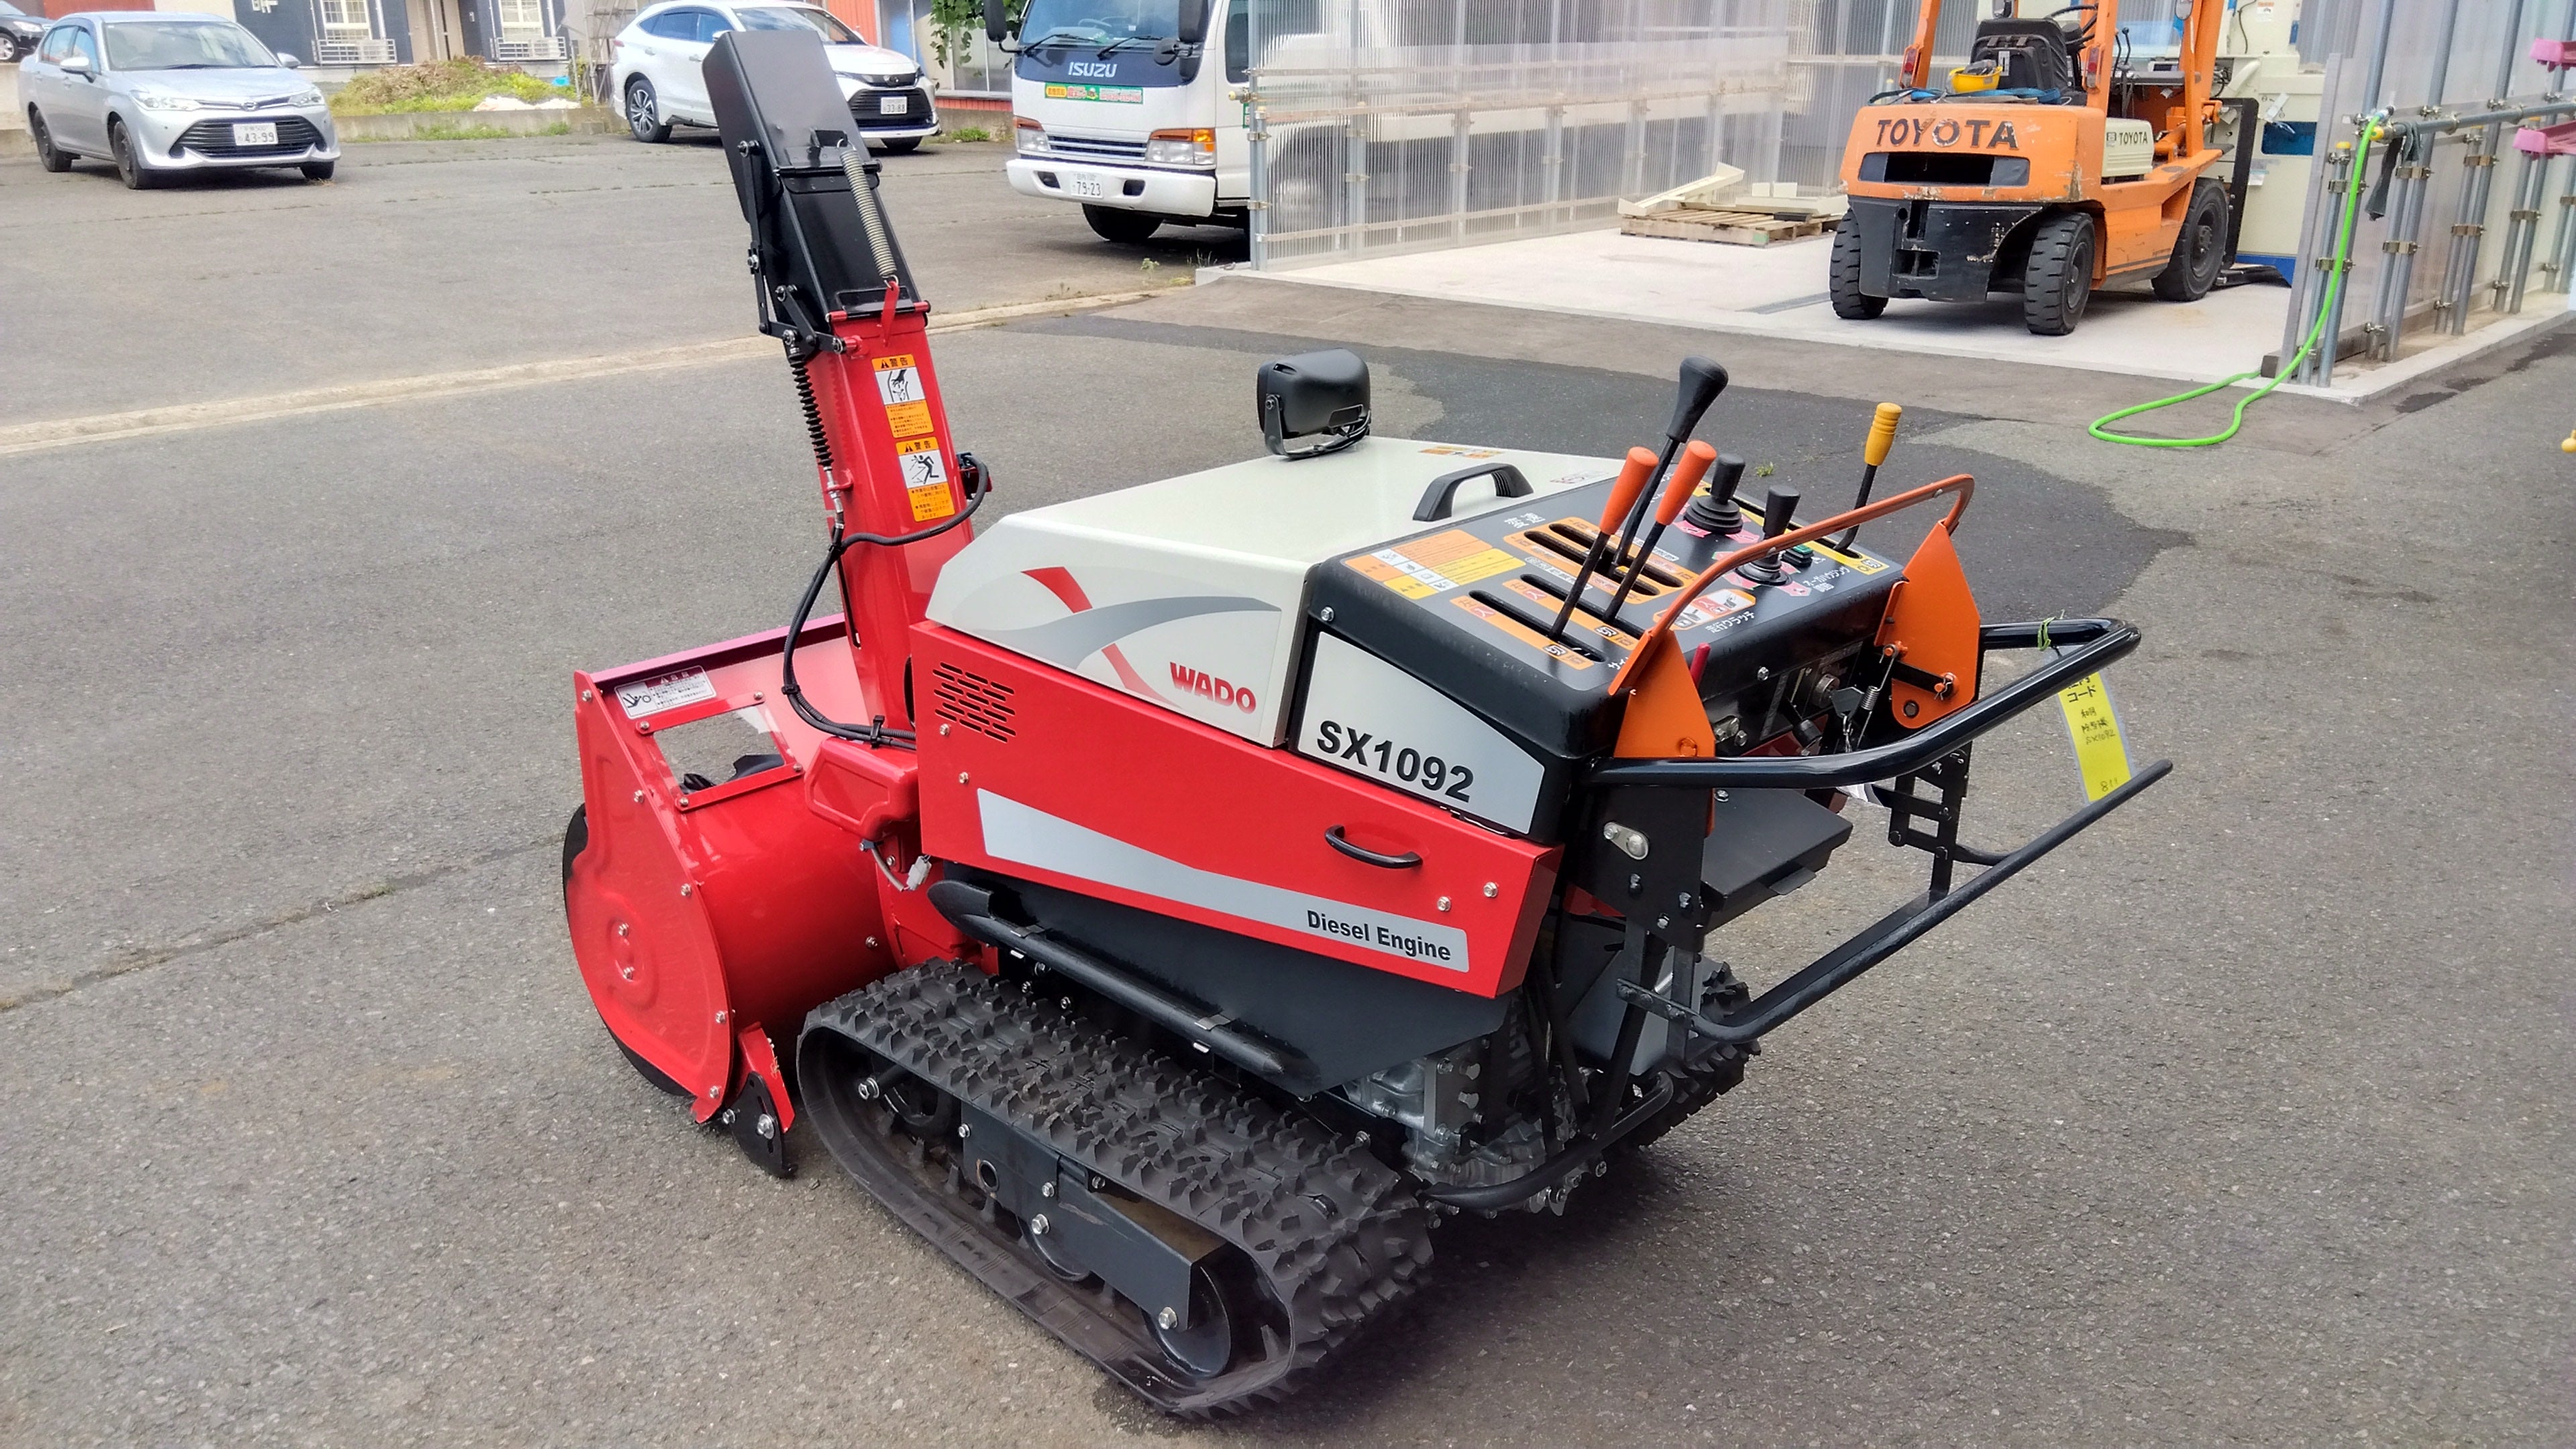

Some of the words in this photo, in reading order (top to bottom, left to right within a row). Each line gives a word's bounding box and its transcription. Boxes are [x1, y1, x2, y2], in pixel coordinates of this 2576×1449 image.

[1068, 62, 1118, 78] ISUZU
[244, 131, 275, 144] 43-99
[1876, 117, 2019, 150] TOYOTA
[2119, 131, 2149, 145] TOYOTA
[1076, 181, 1101, 196] 79-23
[1705, 610, 1755, 633] 走行クラッチ
[1169, 661, 1256, 714] WADO
[2067, 685, 2096, 703] コード
[1316, 720, 1474, 803] SX1092
[1307, 910, 1370, 942] Diesel
[1377, 926, 1451, 961] Engine
